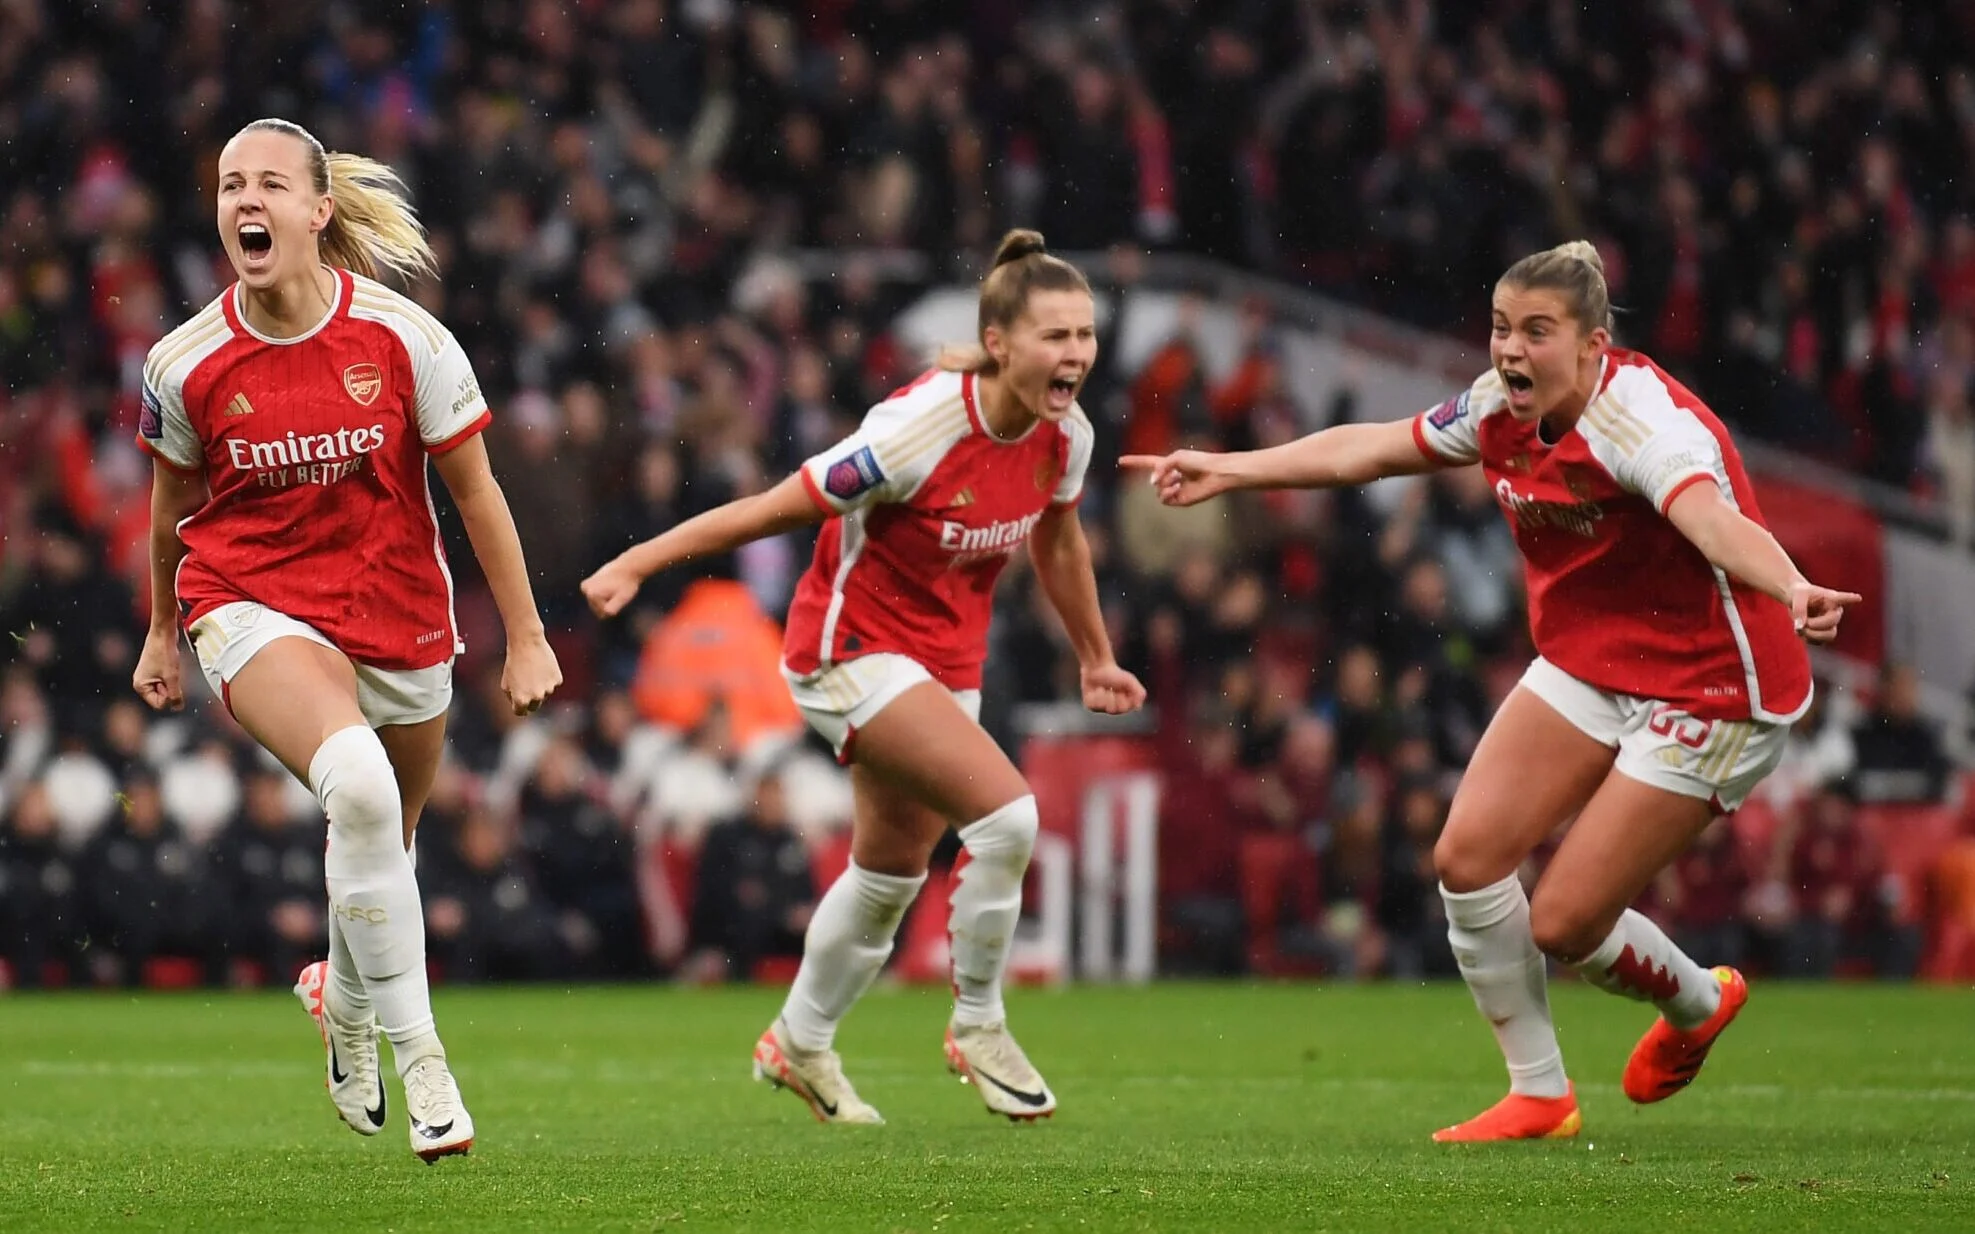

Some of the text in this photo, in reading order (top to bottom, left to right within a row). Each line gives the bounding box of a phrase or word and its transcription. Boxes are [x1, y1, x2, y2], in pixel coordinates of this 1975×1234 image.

[226, 424, 384, 469] Emirates
[257, 456, 363, 488] FLY BETTER
